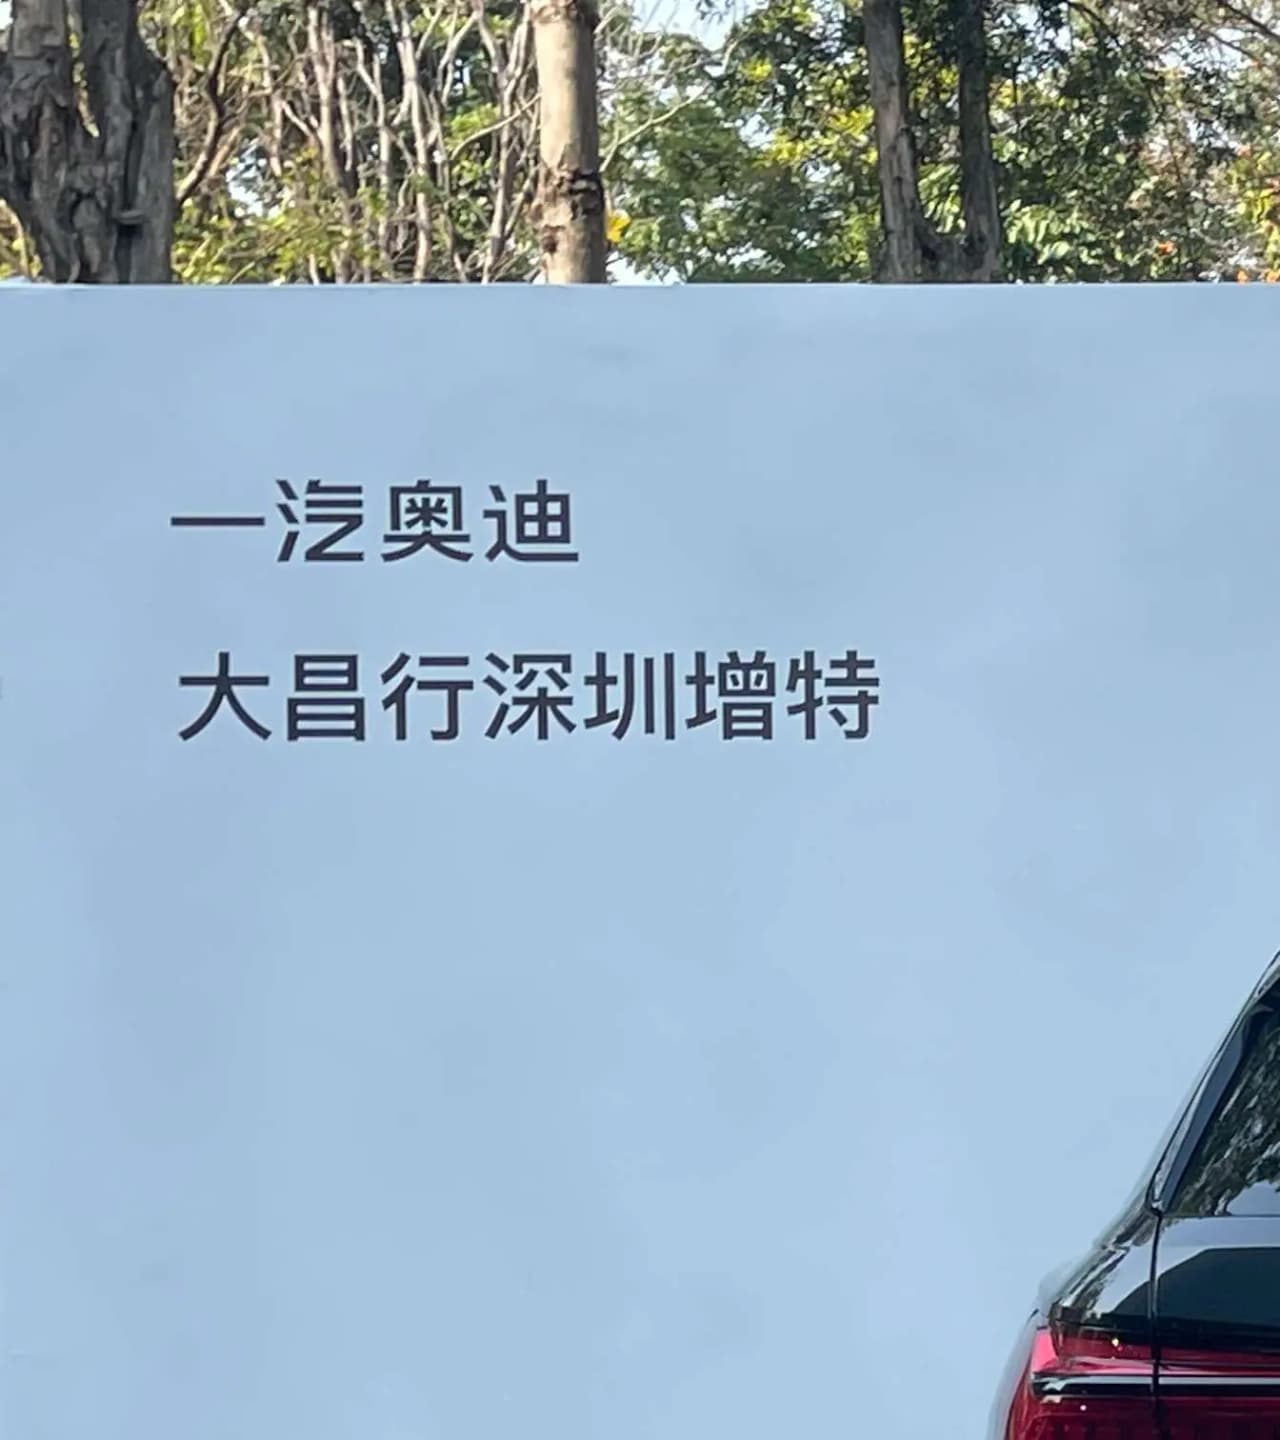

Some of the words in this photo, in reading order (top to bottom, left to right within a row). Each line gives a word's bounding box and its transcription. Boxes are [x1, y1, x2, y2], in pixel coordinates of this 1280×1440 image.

[170, 478, 580, 563] 一汽奥迪
[177, 650, 881, 742] 大昌行深圳增特
